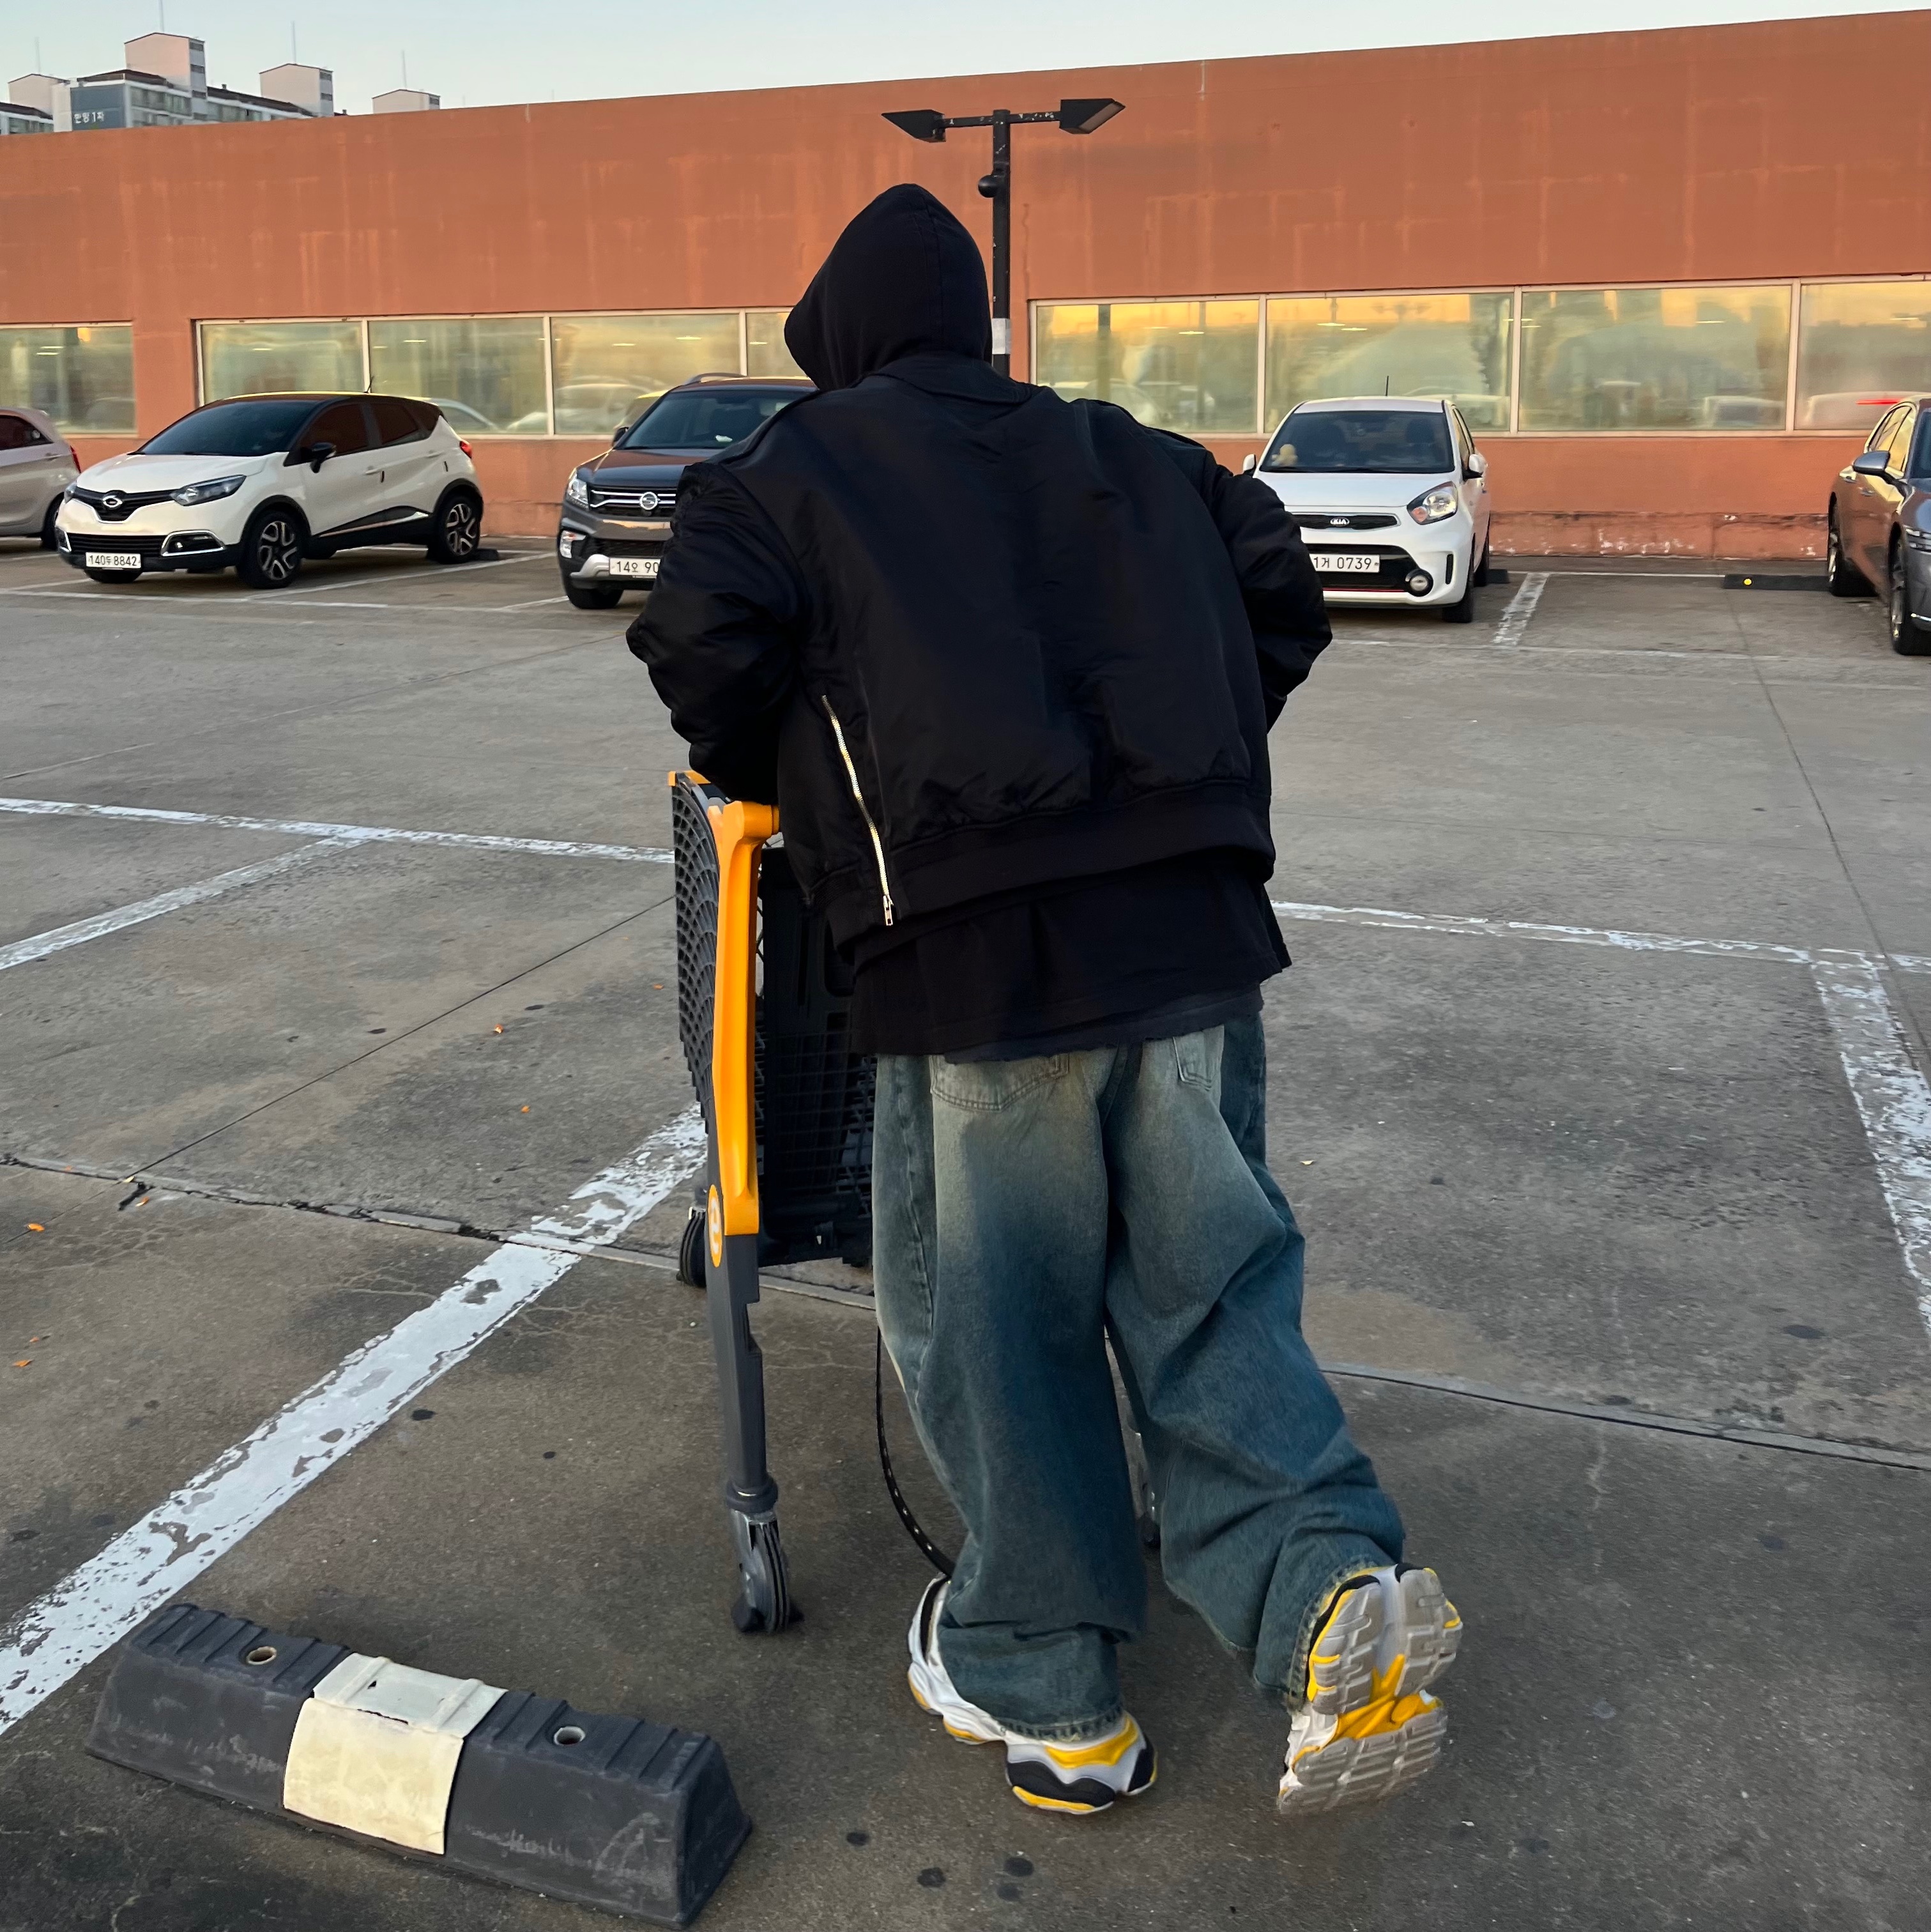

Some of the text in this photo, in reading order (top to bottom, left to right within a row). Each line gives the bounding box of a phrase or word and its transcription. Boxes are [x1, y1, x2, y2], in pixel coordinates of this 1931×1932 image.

[114, 555, 137, 567] 8842
[616, 561, 638, 573] 14오
[1337, 556, 1371, 570] 0739
